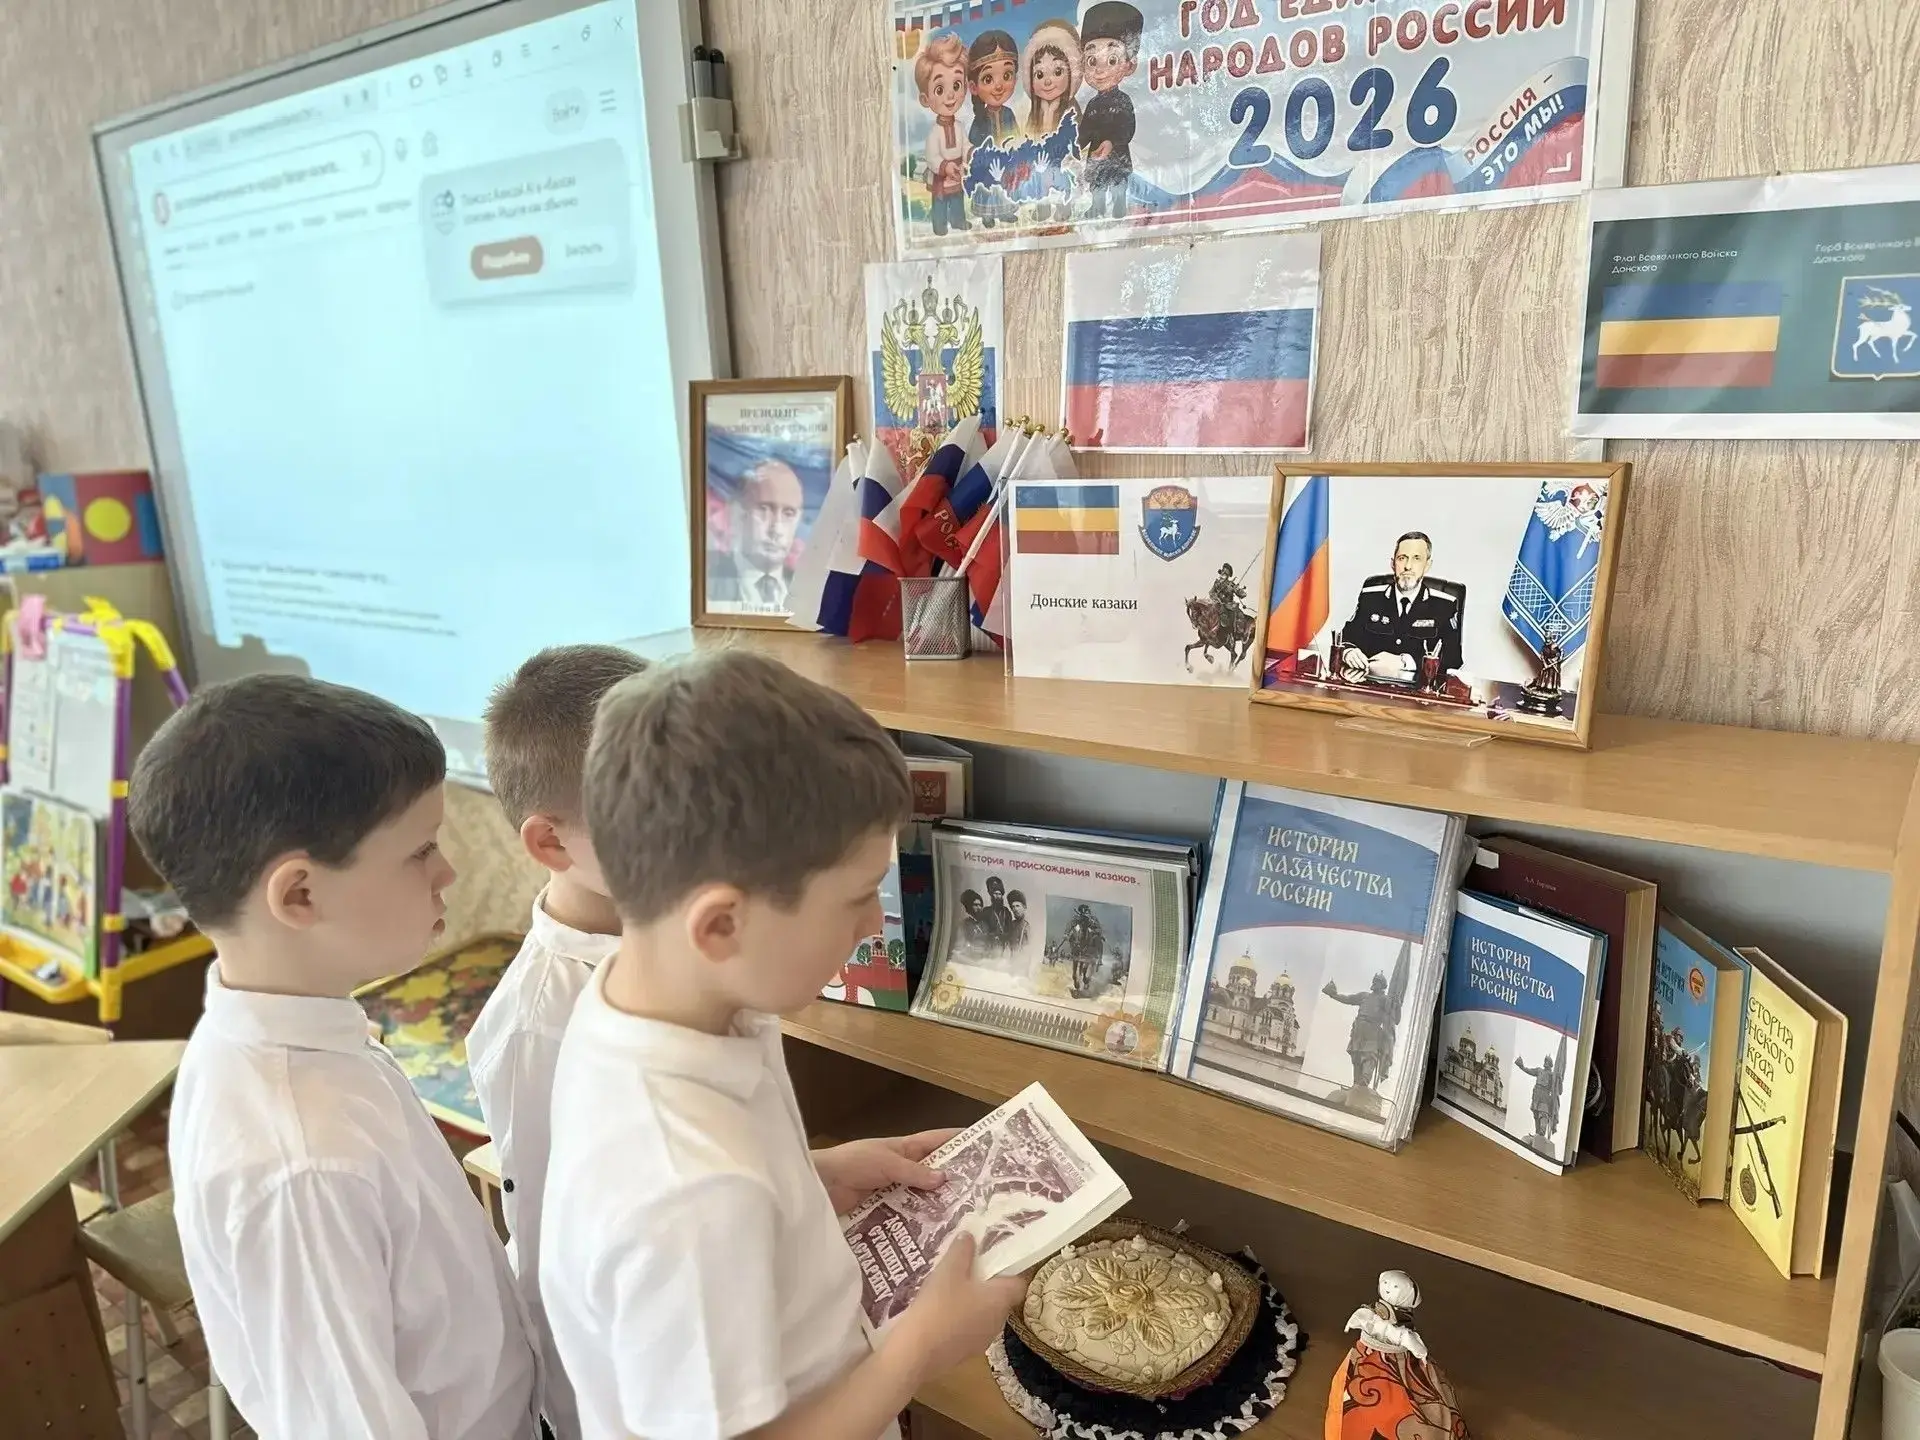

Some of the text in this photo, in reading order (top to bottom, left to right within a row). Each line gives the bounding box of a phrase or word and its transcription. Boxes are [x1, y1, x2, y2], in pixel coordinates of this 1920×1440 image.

[1150, 0, 1565, 91] НАРОДОВ РОССИИ
[1181, 0, 1260, 38] ГОД
[1228, 57, 1457, 168] 2026
[1463, 87, 1537, 166] РОССИЯ
[1481, 93, 1564, 185] ЭТО МЫ!
[1030, 593, 1138, 610] Донские казаки
[963, 851, 1005, 867] История
[1009, 858, 1090, 878] происхождения
[1266, 826, 1359, 864] ИСТОРИЯ
[1256, 876, 1334, 912] РОССИИ
[1261, 851, 1394, 899] КАЗАЧЕСТВА
[1471, 936, 1532, 972] ИСТОРИЯ
[1471, 955, 1555, 1002] КАЗАЧЕСТВА
[1470, 974, 1518, 1006] РОССИИ
[1745, 1016, 1795, 1075] ОНСКОГО
[1748, 996, 1794, 1050] СТОРИЯ
[920, 1107, 1007, 1168] БРАЗОВАНИЕ
[868, 1225, 909, 1287] СТАНИЦА
[882, 1213, 927, 1272] ДОНСКАЯ
[854, 1242, 894, 1303] СТАРИНУ
